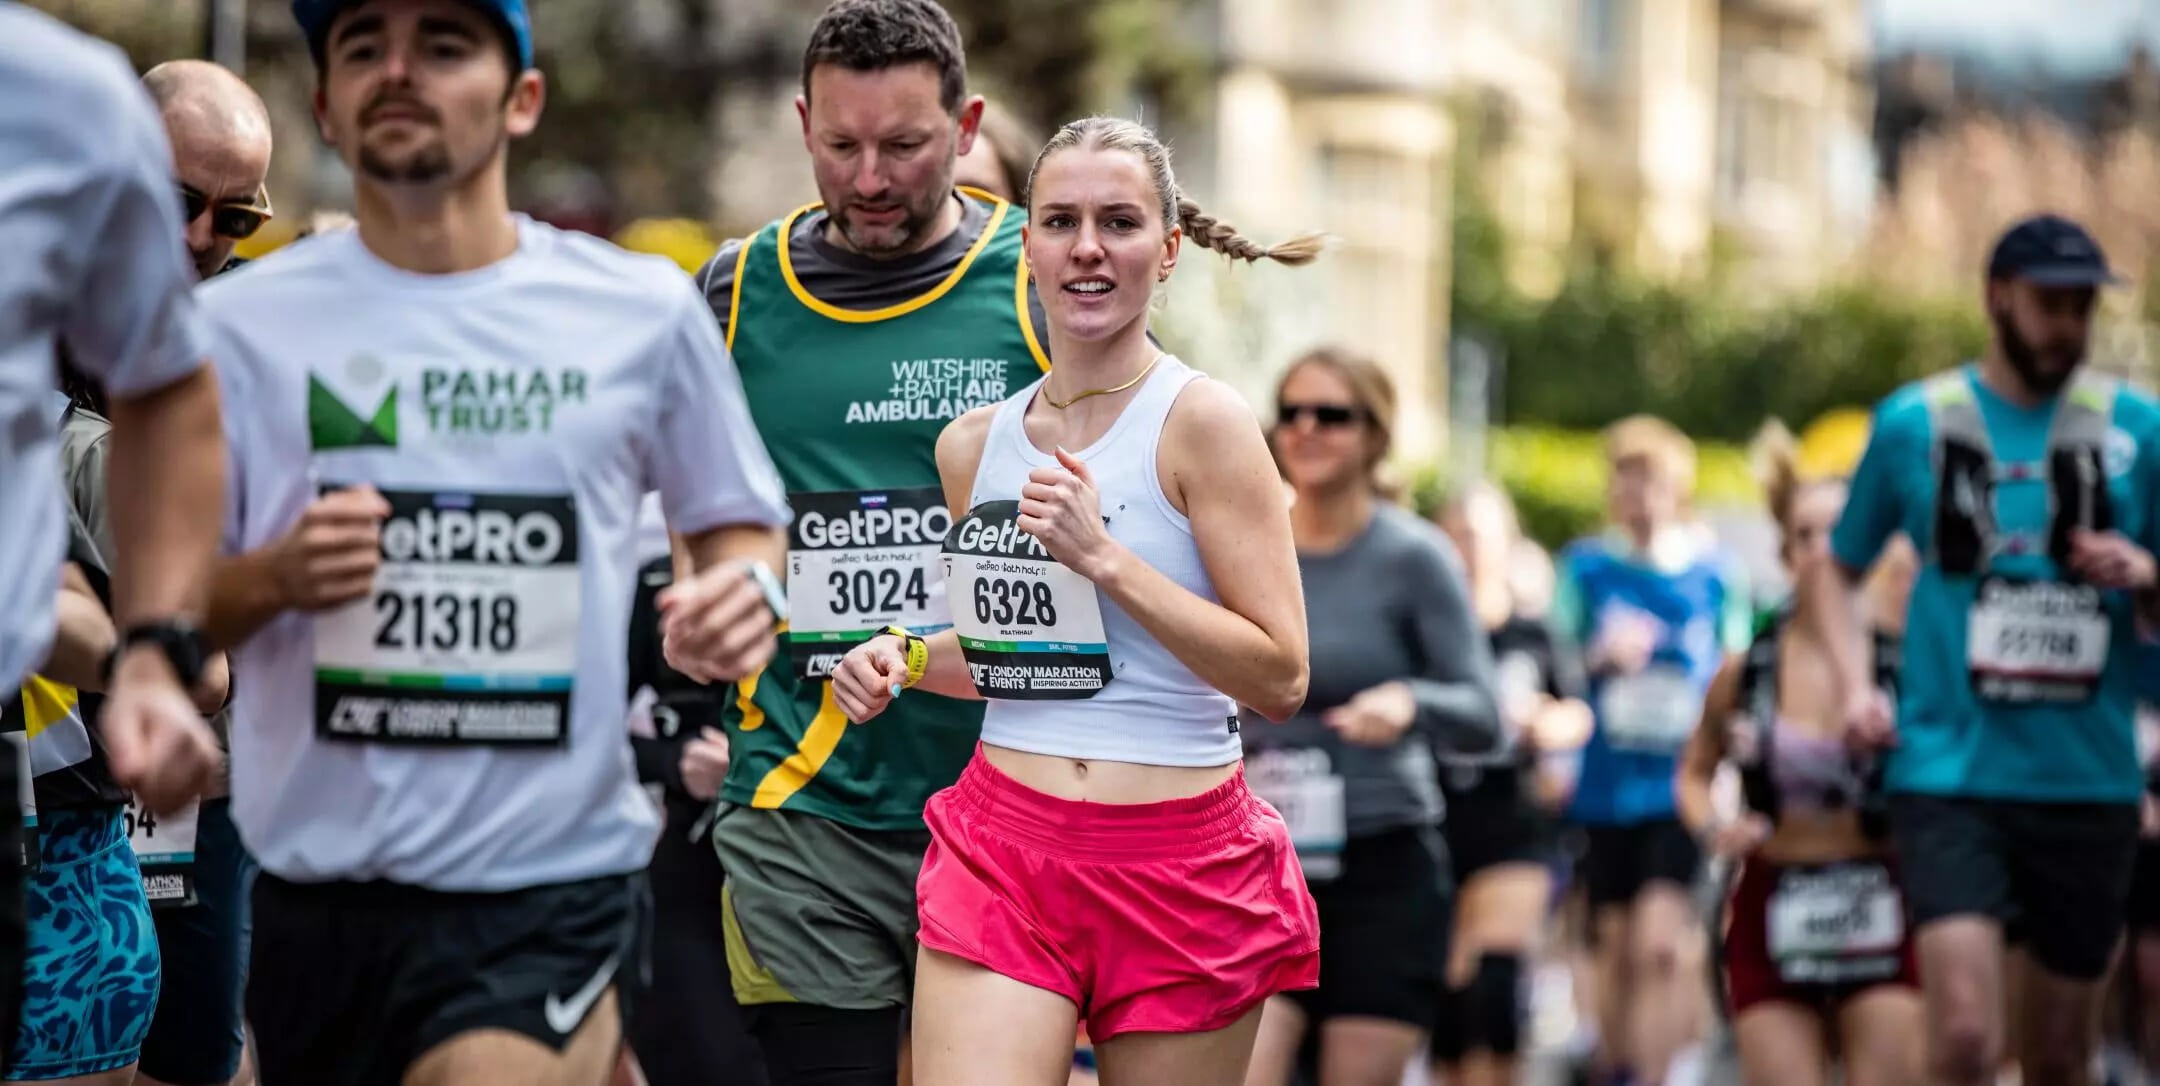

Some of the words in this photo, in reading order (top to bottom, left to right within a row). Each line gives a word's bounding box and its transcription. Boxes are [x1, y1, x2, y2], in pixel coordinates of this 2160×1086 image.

[422, 368, 588, 401] PAHAR
[892, 358, 1008, 381] WILTSHIRE
[426, 404, 554, 433] TRUST
[845, 399, 998, 423] AMBULAN
[382, 508, 563, 565] etPRO
[799, 506, 953, 548] GetPRO
[959, 517, 1048, 557] GetPR
[828, 567, 929, 614] 3024
[974, 577, 1057, 627] 6328
[375, 593, 518, 653] 21318
[989, 665, 1032, 678] LONDON
[1034, 666, 1101, 678] MARATHON
[989, 677, 1026, 690] EVENTS
[1033, 679, 1068, 688] INSPIRING
[1069, 679, 1100, 688] ACTIVITY
[144, 874, 184, 889] RATHON
